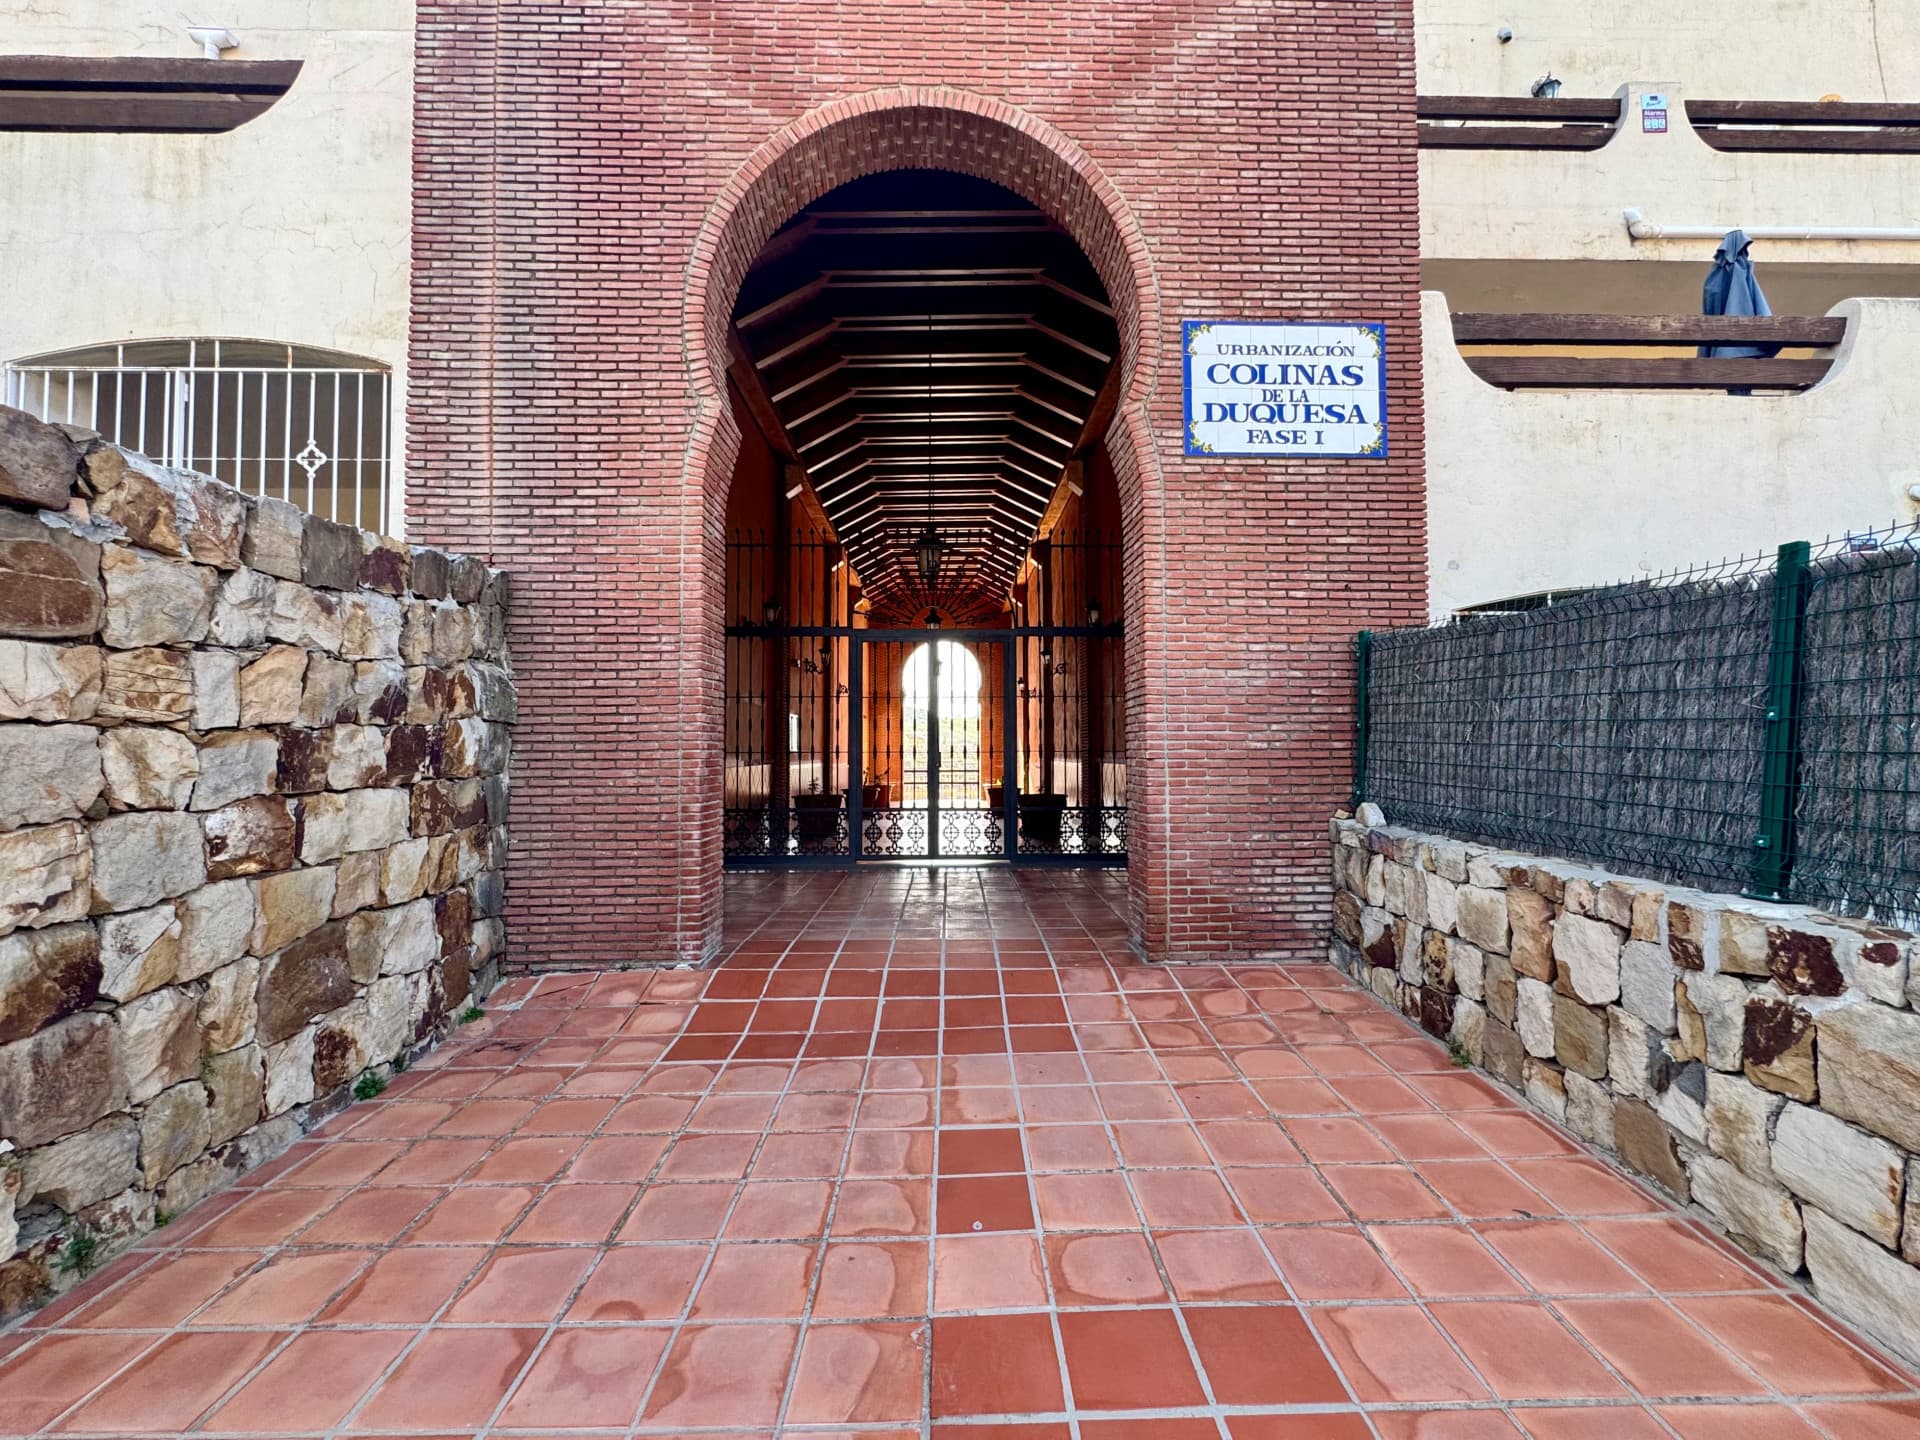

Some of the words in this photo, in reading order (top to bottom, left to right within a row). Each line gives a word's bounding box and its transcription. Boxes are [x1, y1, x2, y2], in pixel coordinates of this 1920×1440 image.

[1216, 341, 1355, 357] URBANIZACIÓN
[1206, 363, 1364, 386] COLINAS
[1262, 389, 1283, 402] DE
[1290, 389, 1310, 403] LA
[1202, 402, 1368, 424] DUQUESA
[1246, 429, 1307, 444] FASE
[1314, 430, 1325, 445] I
